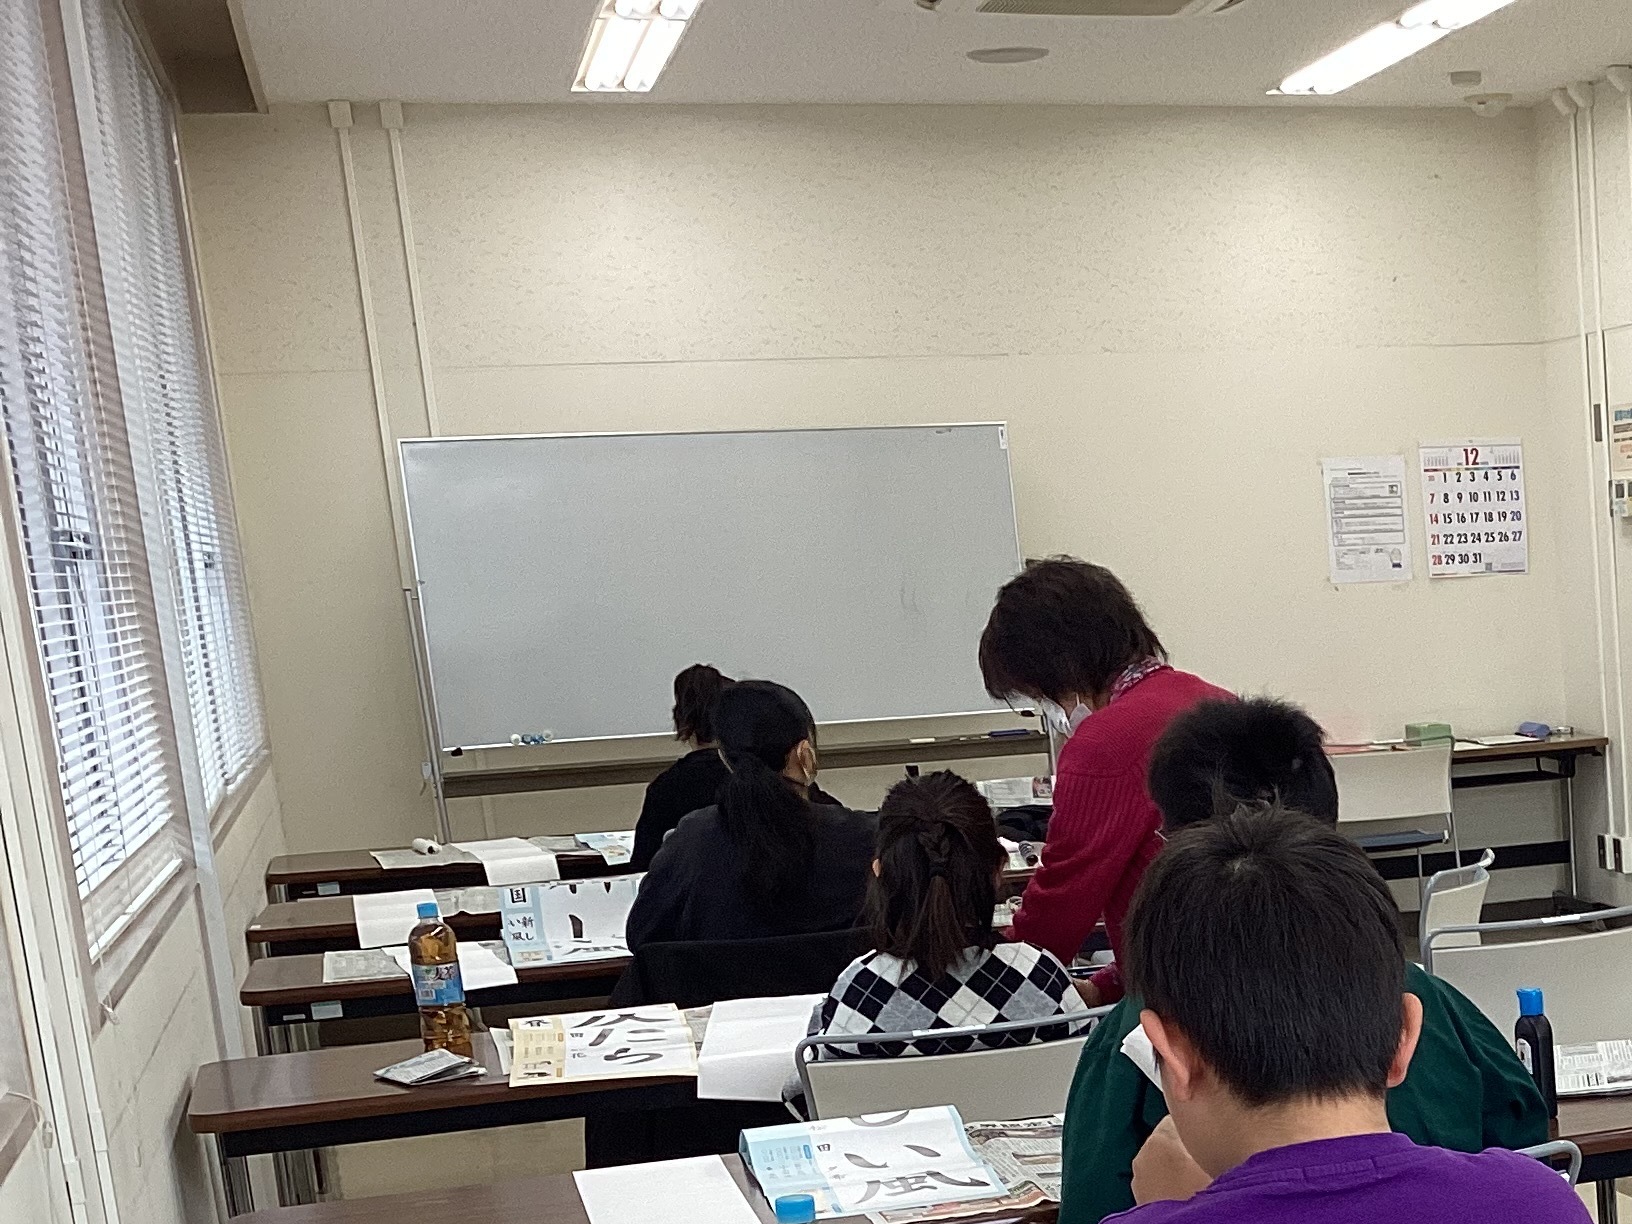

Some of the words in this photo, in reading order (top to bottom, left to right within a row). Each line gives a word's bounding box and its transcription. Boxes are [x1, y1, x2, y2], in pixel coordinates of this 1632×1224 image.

[1463, 447, 1480, 466] 12
[1443, 472, 1447, 483] 1
[1456, 471, 1461, 482] 2
[1470, 471, 1475, 482] 3
[1483, 471, 1489, 481] 4
[1497, 470, 1502, 481] 5
[1510, 470, 1516, 480] 6
[1429, 493, 1435, 504] 7
[1443, 493, 1449, 503] 8
[1457, 492, 1463, 503] 9
[1469, 491, 1478, 502] 10
[1483, 491, 1491, 502] 11
[1496, 490, 1506, 501] 12
[1510, 490, 1520, 501] 13
[1429, 513, 1439, 524] 14
[1443, 513, 1452, 524] 15
[1456, 512, 1466, 524] 16
[1470, 512, 1479, 523] 17
[1484, 511, 1494, 522] 18
[1497, 511, 1507, 522] 19
[1510, 510, 1521, 521] 20
[1431, 534, 1440, 545] 21
[1443, 533, 1454, 545] 22
[1456, 533, 1468, 544] 23
[1470, 532, 1481, 543] 24
[1484, 531, 1495, 543] 25
[1498, 531, 1509, 542] 26
[1511, 530, 1522, 541] 27
[1431, 554, 1442, 565] 28
[1444, 554, 1455, 565] 29
[1458, 553, 1469, 564] 30
[1472, 553, 1482, 563] 31
